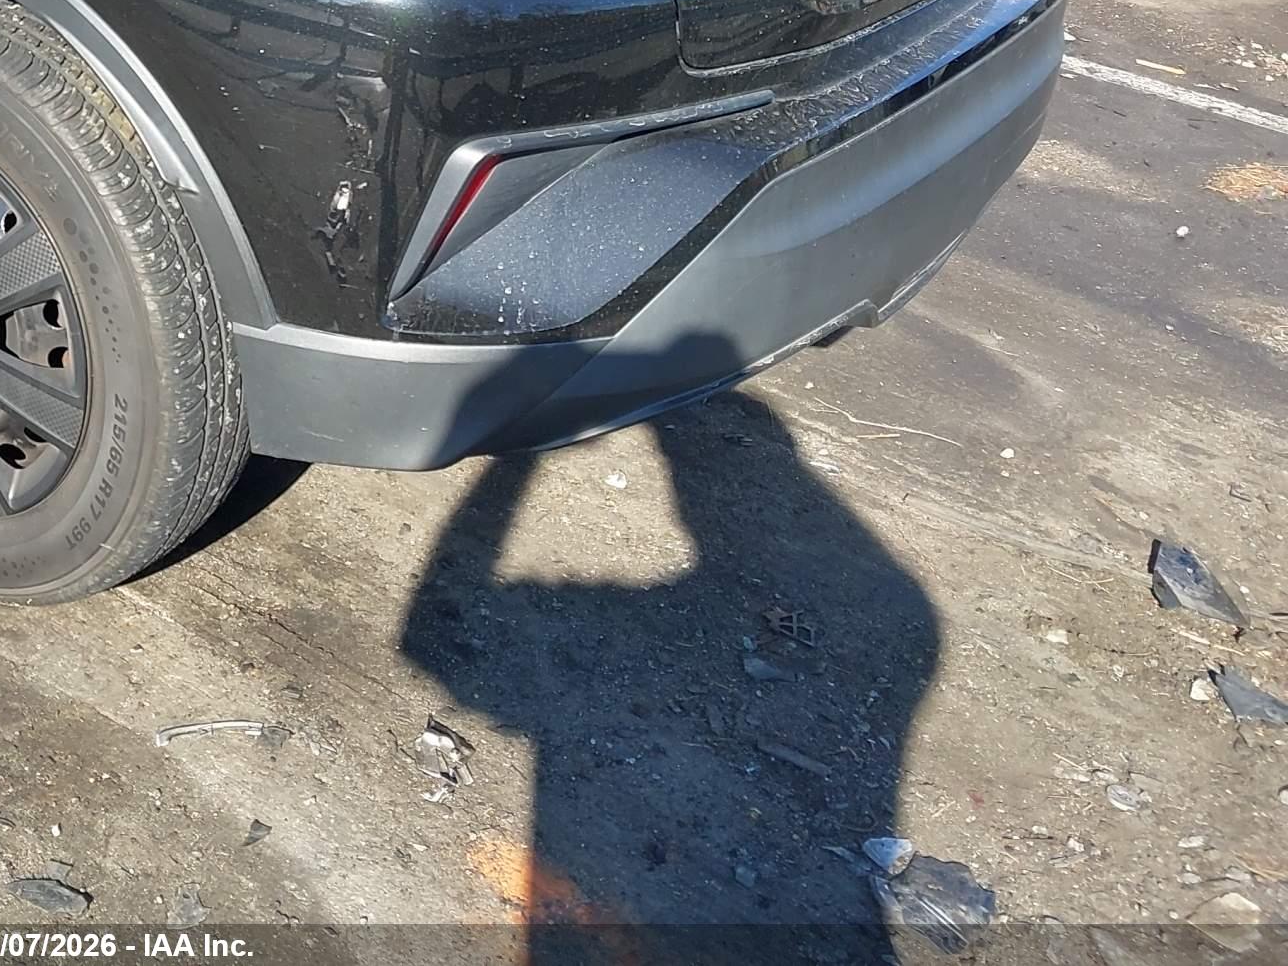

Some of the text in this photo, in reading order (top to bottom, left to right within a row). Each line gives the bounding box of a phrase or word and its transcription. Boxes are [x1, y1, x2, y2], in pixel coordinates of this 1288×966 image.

[64, 393, 128, 550] 215/65 R17 99T
